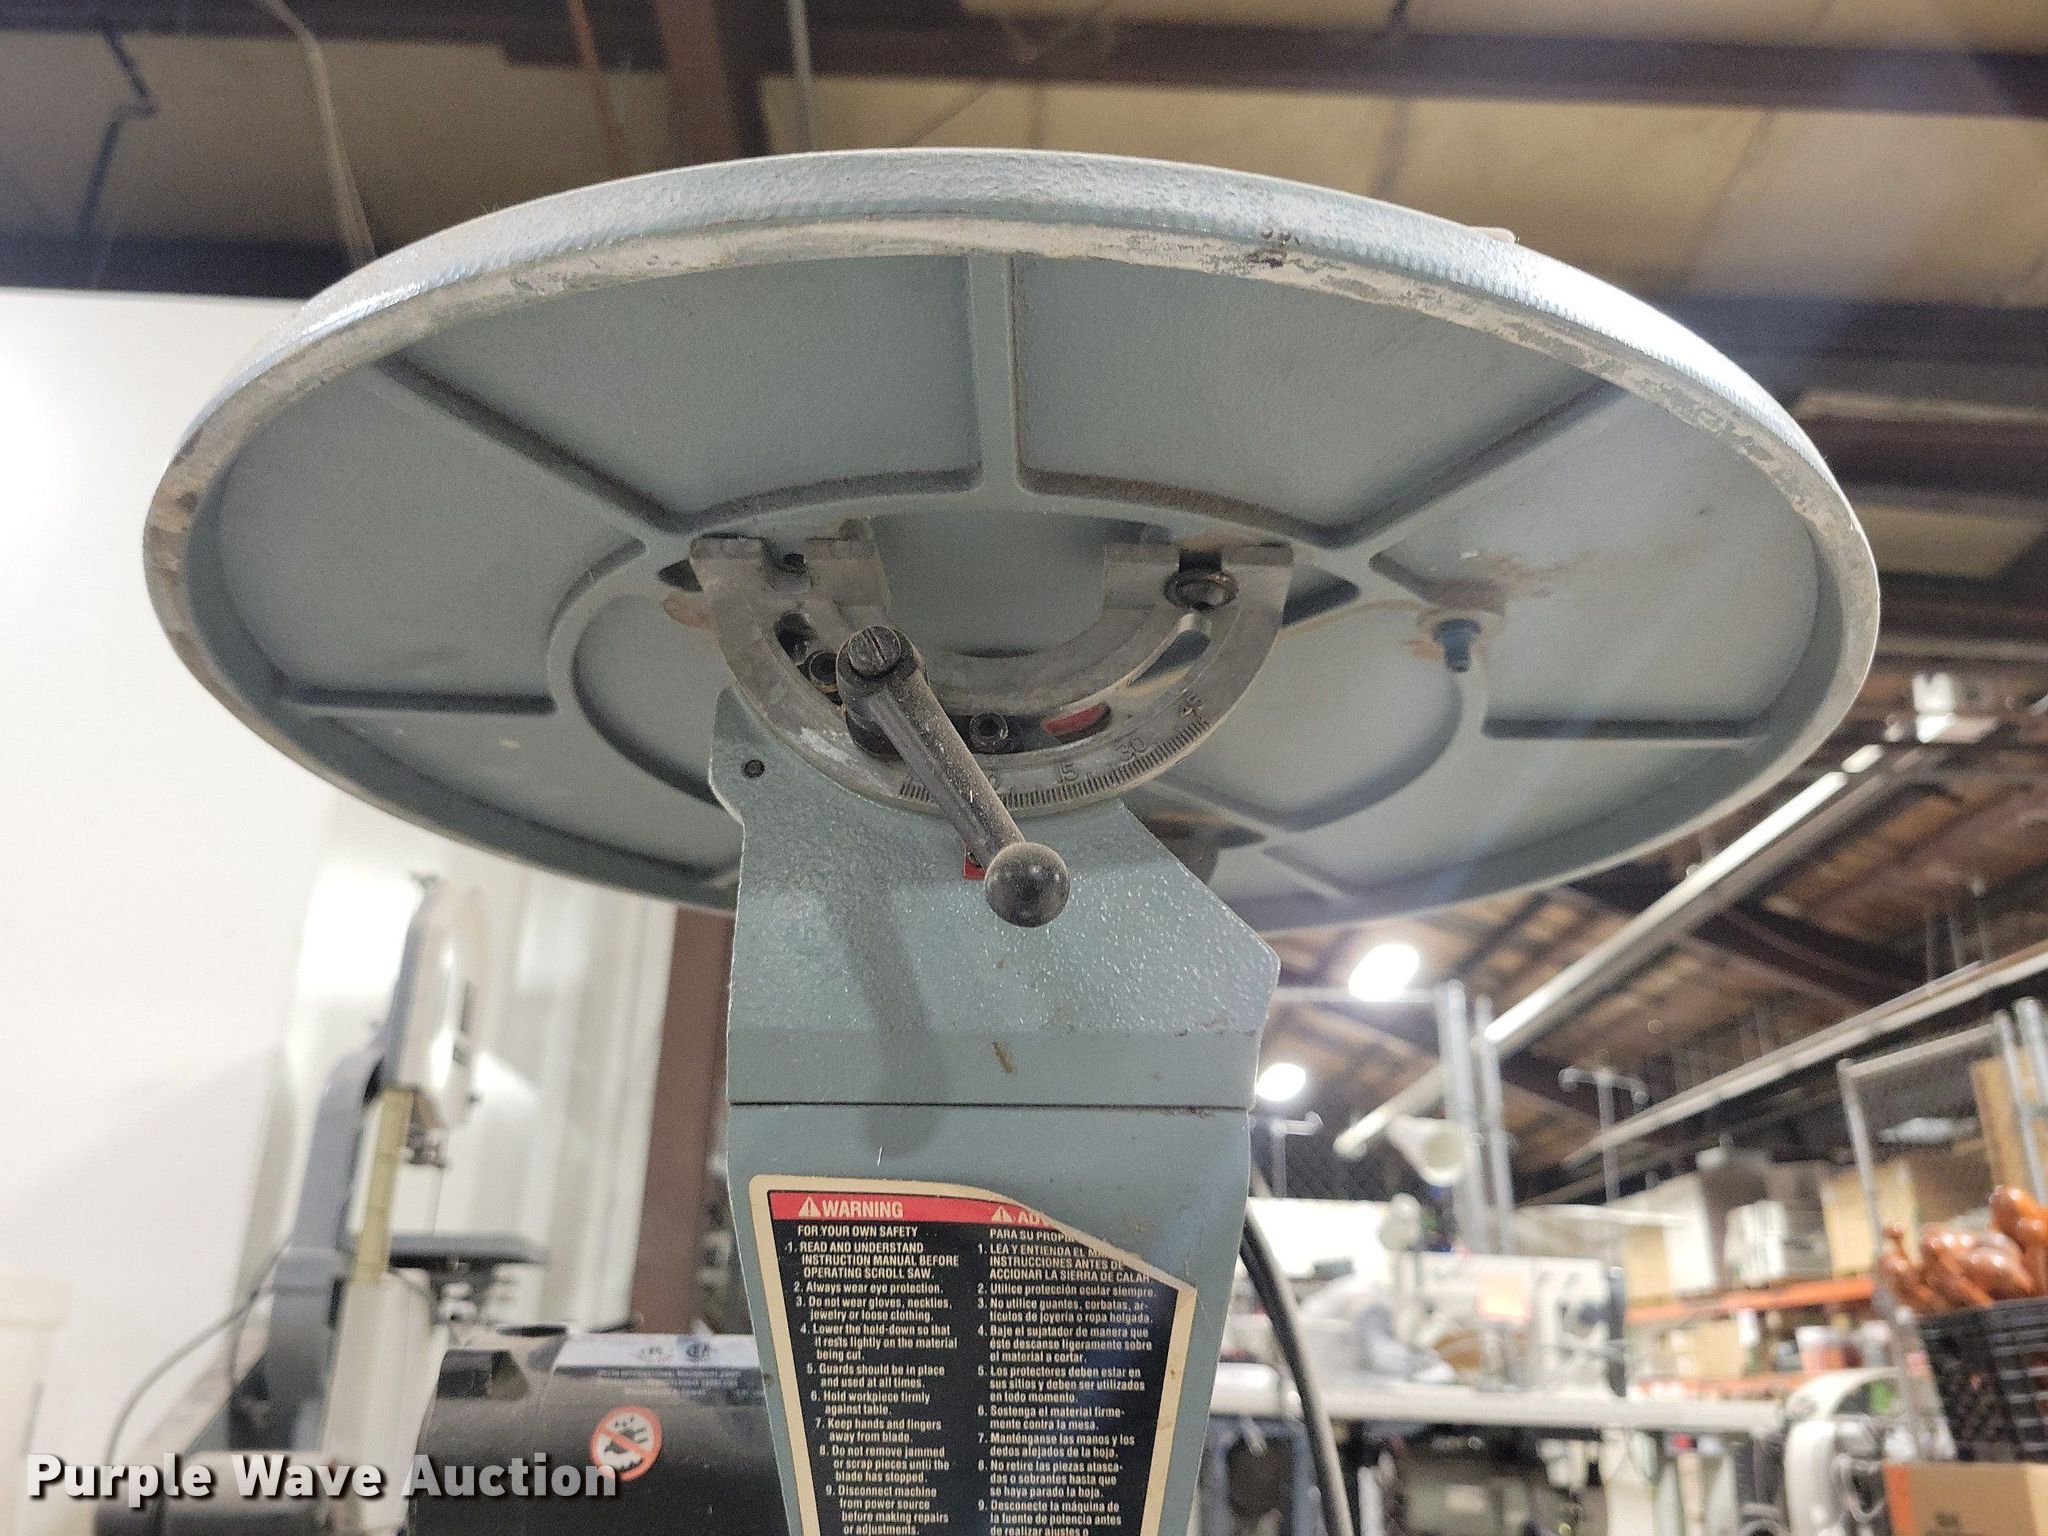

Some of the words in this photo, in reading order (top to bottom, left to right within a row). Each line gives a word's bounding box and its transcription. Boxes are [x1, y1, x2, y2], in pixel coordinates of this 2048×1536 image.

[1056, 762, 1081, 784] 15
[822, 1201, 904, 1218] WARNING
[798, 1225, 818, 1236] FOR
[822, 1226, 849, 1237] YOUR
[852, 1226, 877, 1237] OWN
[879, 1226, 918, 1238] SAFETY
[990, 1228, 1017, 1240] PARA
[1019, 1229, 1034, 1241] SU
[800, 1242, 827, 1253] READ
[829, 1242, 851, 1253] AND
[854, 1242, 924, 1254] UNDERSTAND
[990, 1244, 1009, 1255] LEA
[1011, 1244, 1017, 1255] Y
[1020, 1244, 1071, 1257] ENTIENDA
[1073, 1246, 1086, 1257] EL
[801, 1254, 870, 1266] INSTRUCTION
[873, 1255, 916, 1266] MANUAL
[919, 1255, 959, 1267] BEFORE
[990, 1256, 1072, 1269] INSTRUCCIONES
[1075, 1258, 1108, 1270] ANTES
[804, 1267, 862, 1279] OPERATING
[864, 1268, 903, 1279] SCROLL
[907, 1269, 934, 1280] SAW.
[990, 1268, 1042, 1280] ACCIONAR
[1044, 1270, 1058, 1281] LA
[1060, 1270, 1099, 1282] SIERRA
[1101, 1271, 1114, 1282] DE
[806, 1282, 841, 1295] Always
[844, 1284, 867, 1293] wear
[870, 1285, 887, 1295] eye
[890, 1282, 943, 1296] protection.
[990, 1284, 1022, 1295] Utilice
[1079, 1285, 1110, 1296] ocular
